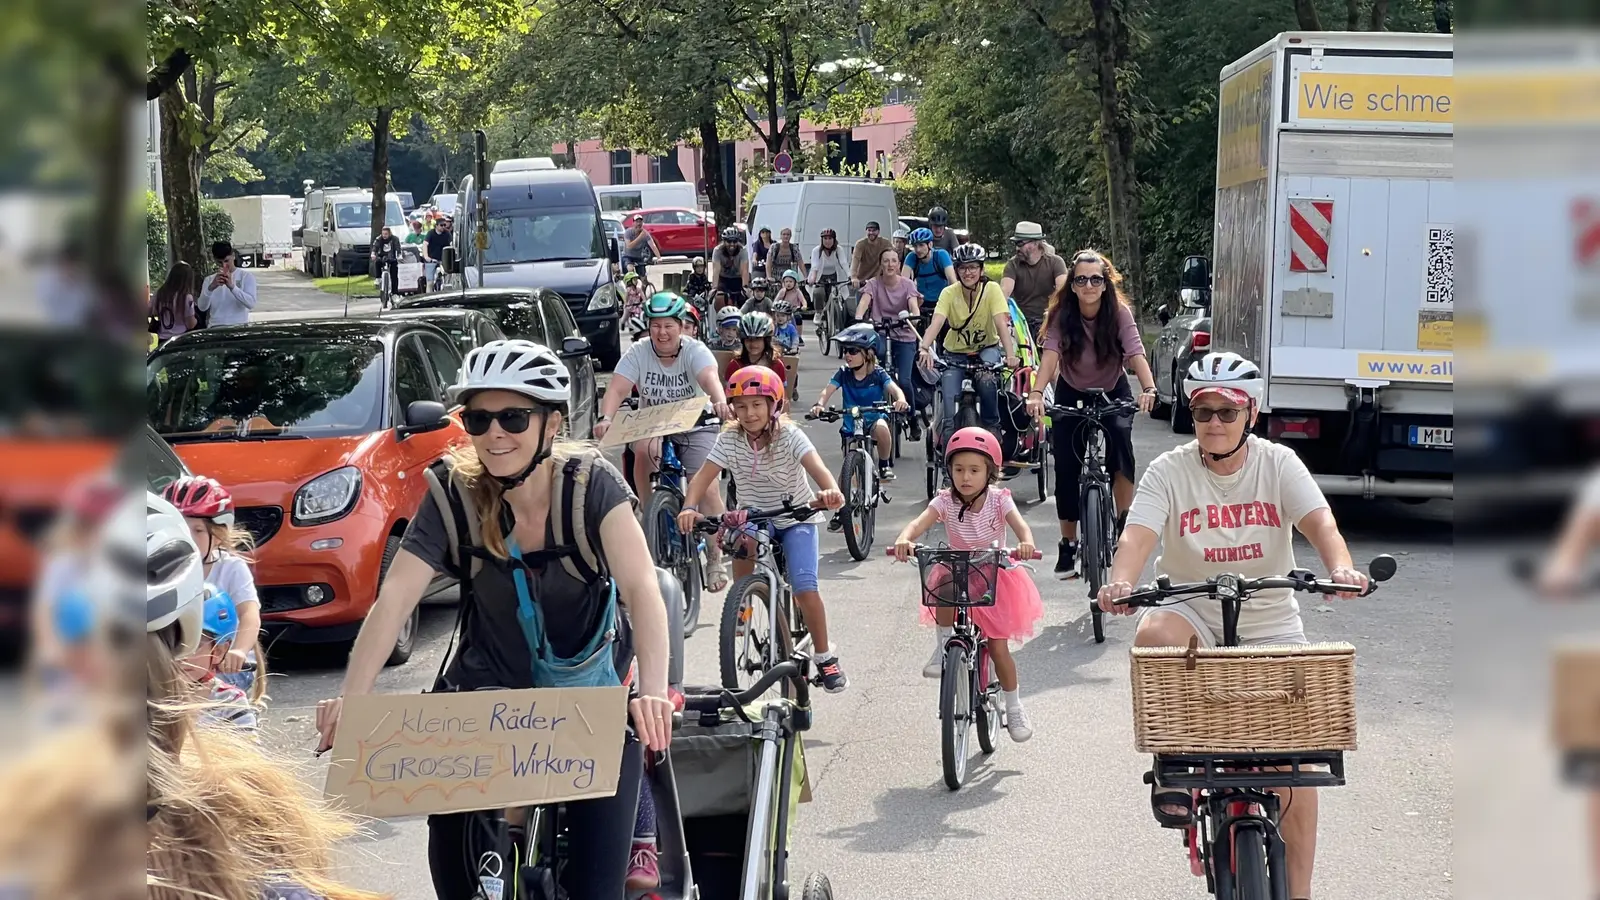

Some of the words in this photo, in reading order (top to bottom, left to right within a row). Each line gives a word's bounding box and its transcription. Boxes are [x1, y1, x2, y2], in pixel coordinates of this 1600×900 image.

[1304, 83, 1354, 110] Wie
[1366, 85, 1451, 113] schme
[650, 388, 664, 397] MY
[1423, 428, 1434, 443] M
[1180, 507, 1202, 538] FC
[1206, 500, 1282, 529] BAYERN
[1203, 542, 1264, 563] MUNICH
[400, 707, 480, 733] kleine
[489, 701, 567, 732] Räder
[365, 743, 495, 783] GROSSE
[511, 742, 596, 790] Wirkung
